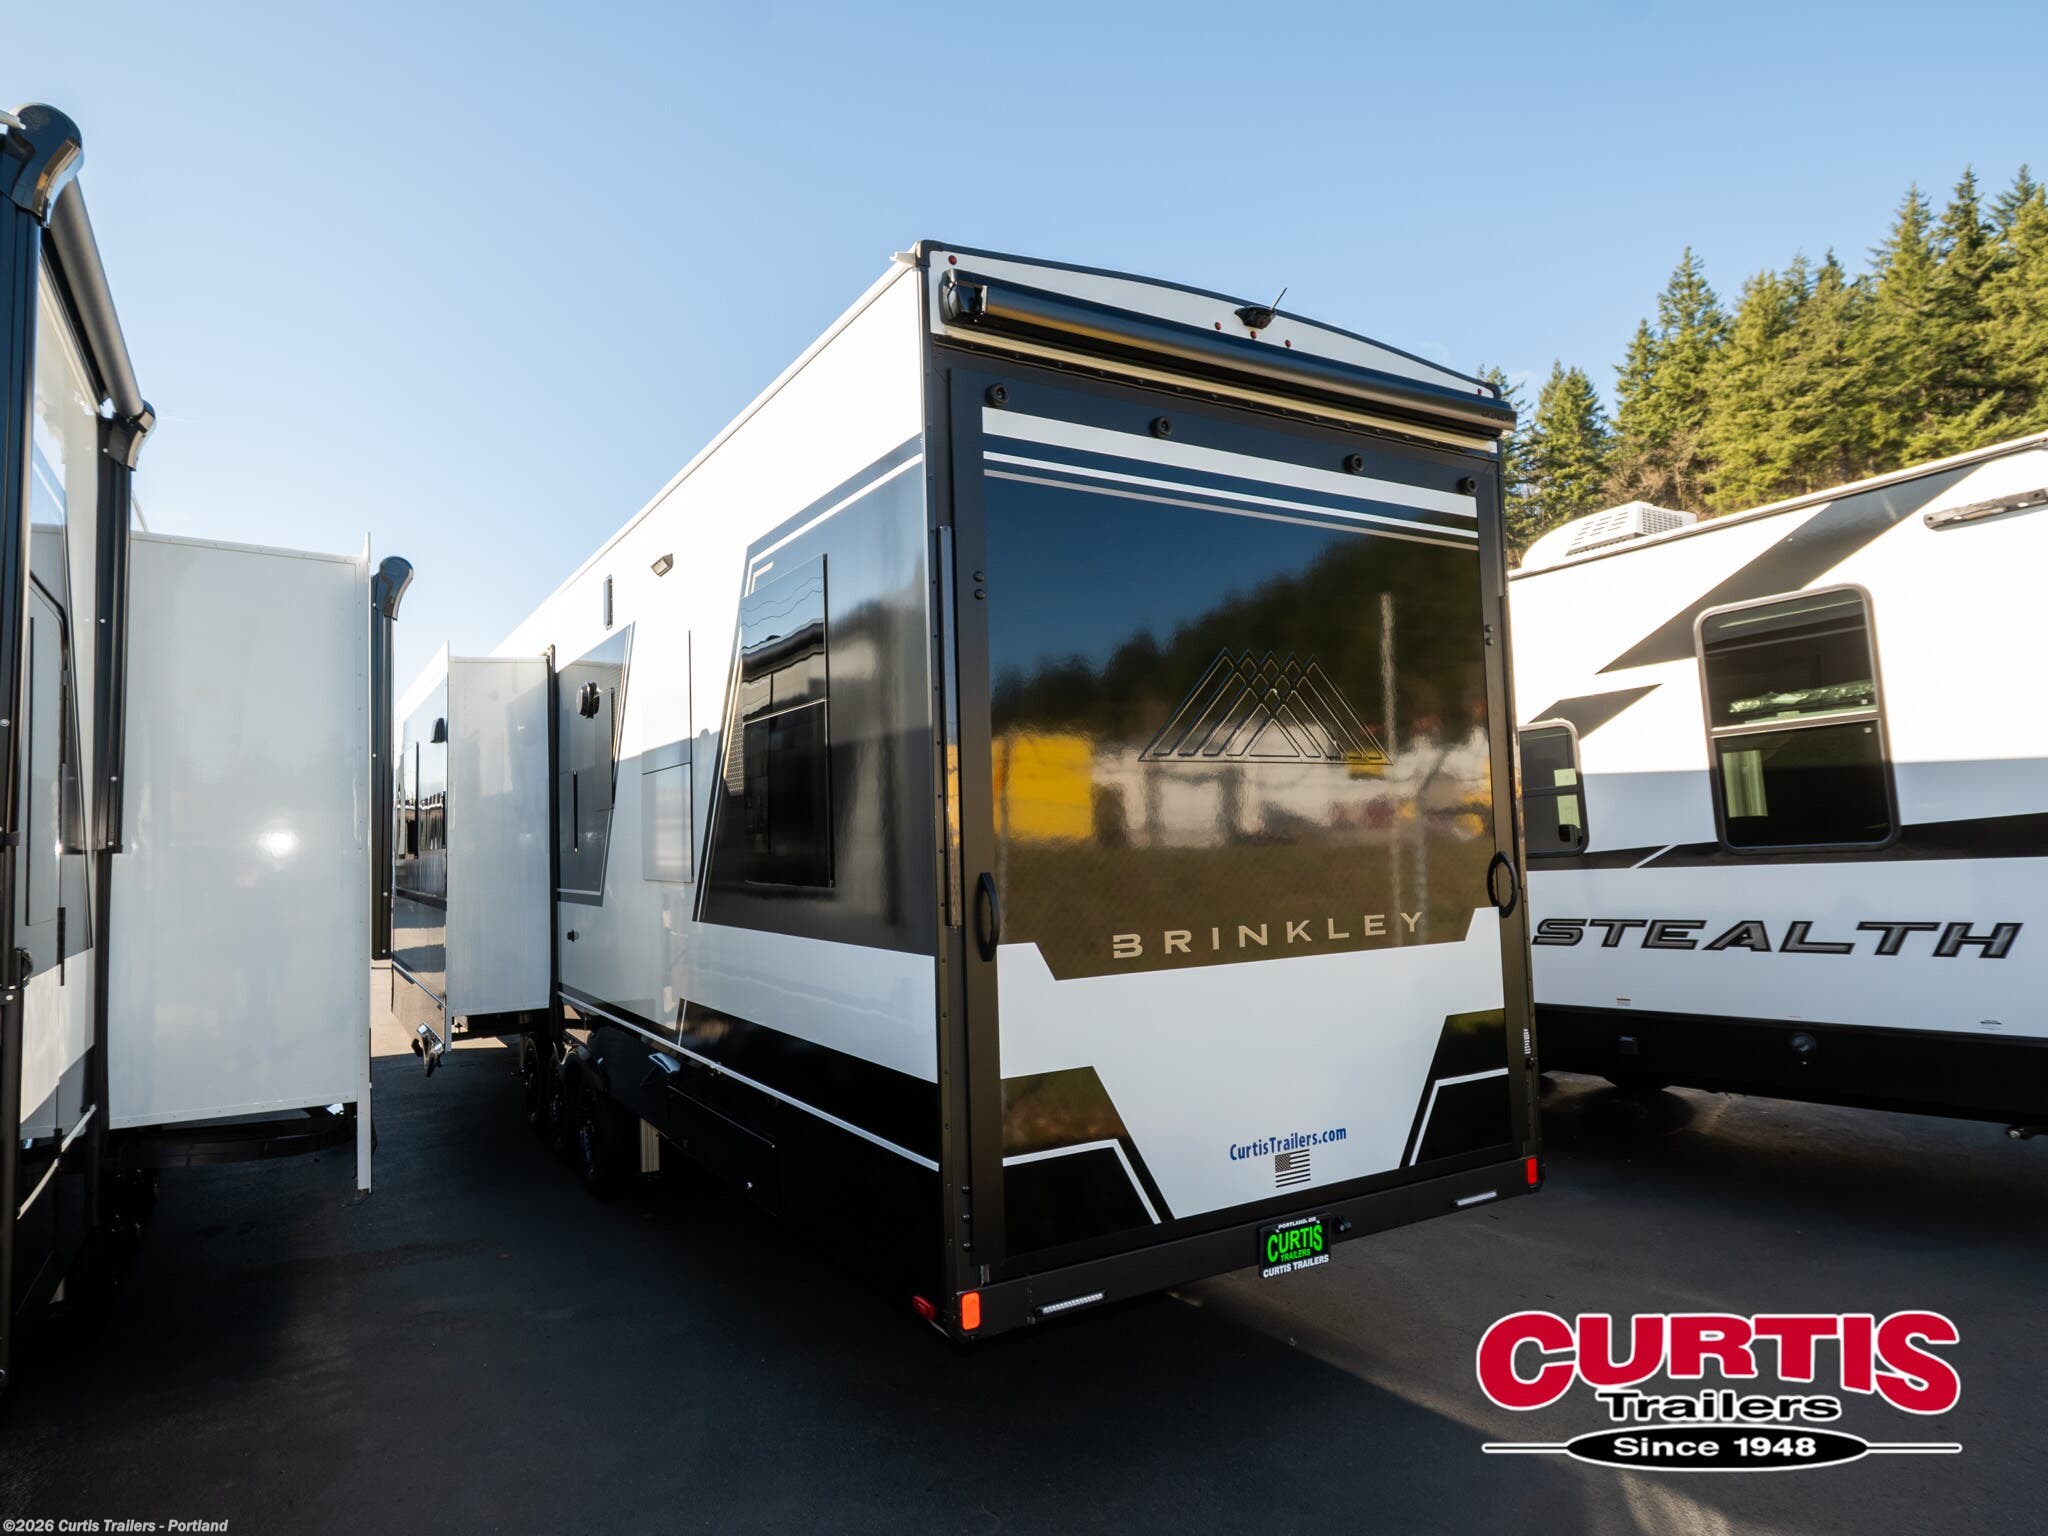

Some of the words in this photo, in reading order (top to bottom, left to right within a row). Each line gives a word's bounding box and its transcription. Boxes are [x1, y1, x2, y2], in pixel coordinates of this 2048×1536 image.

[1112, 911, 1424, 960] BRINKLEY
[1532, 918, 2024, 960] STEALTH
[1229, 1126, 1347, 1161] CurtisTrailers.com
[1267, 1225, 1323, 1263] CURTIS
[1281, 1249, 1311, 1261] TRAILERS
[1263, 1263, 1292, 1278] CURTIS
[1293, 1254, 1329, 1270] TRAILERS
